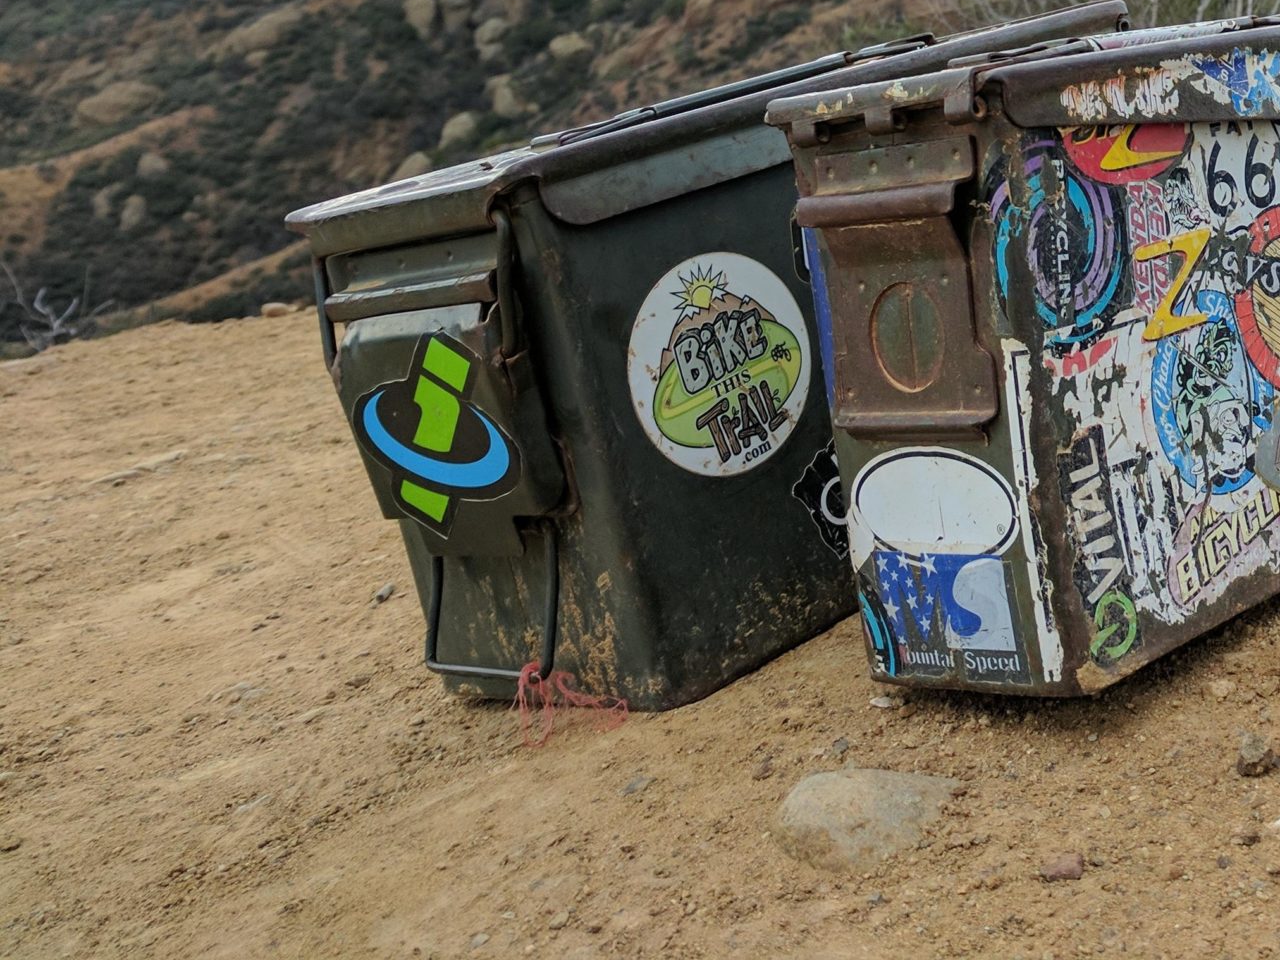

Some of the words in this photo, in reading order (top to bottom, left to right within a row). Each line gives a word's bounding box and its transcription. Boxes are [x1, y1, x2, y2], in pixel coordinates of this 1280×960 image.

[711, 368, 752, 398] THIS
[742, 440, 772, 465] .com
[1069, 438, 1124, 604] VITAL
[964, 650, 1022, 674] Speed
